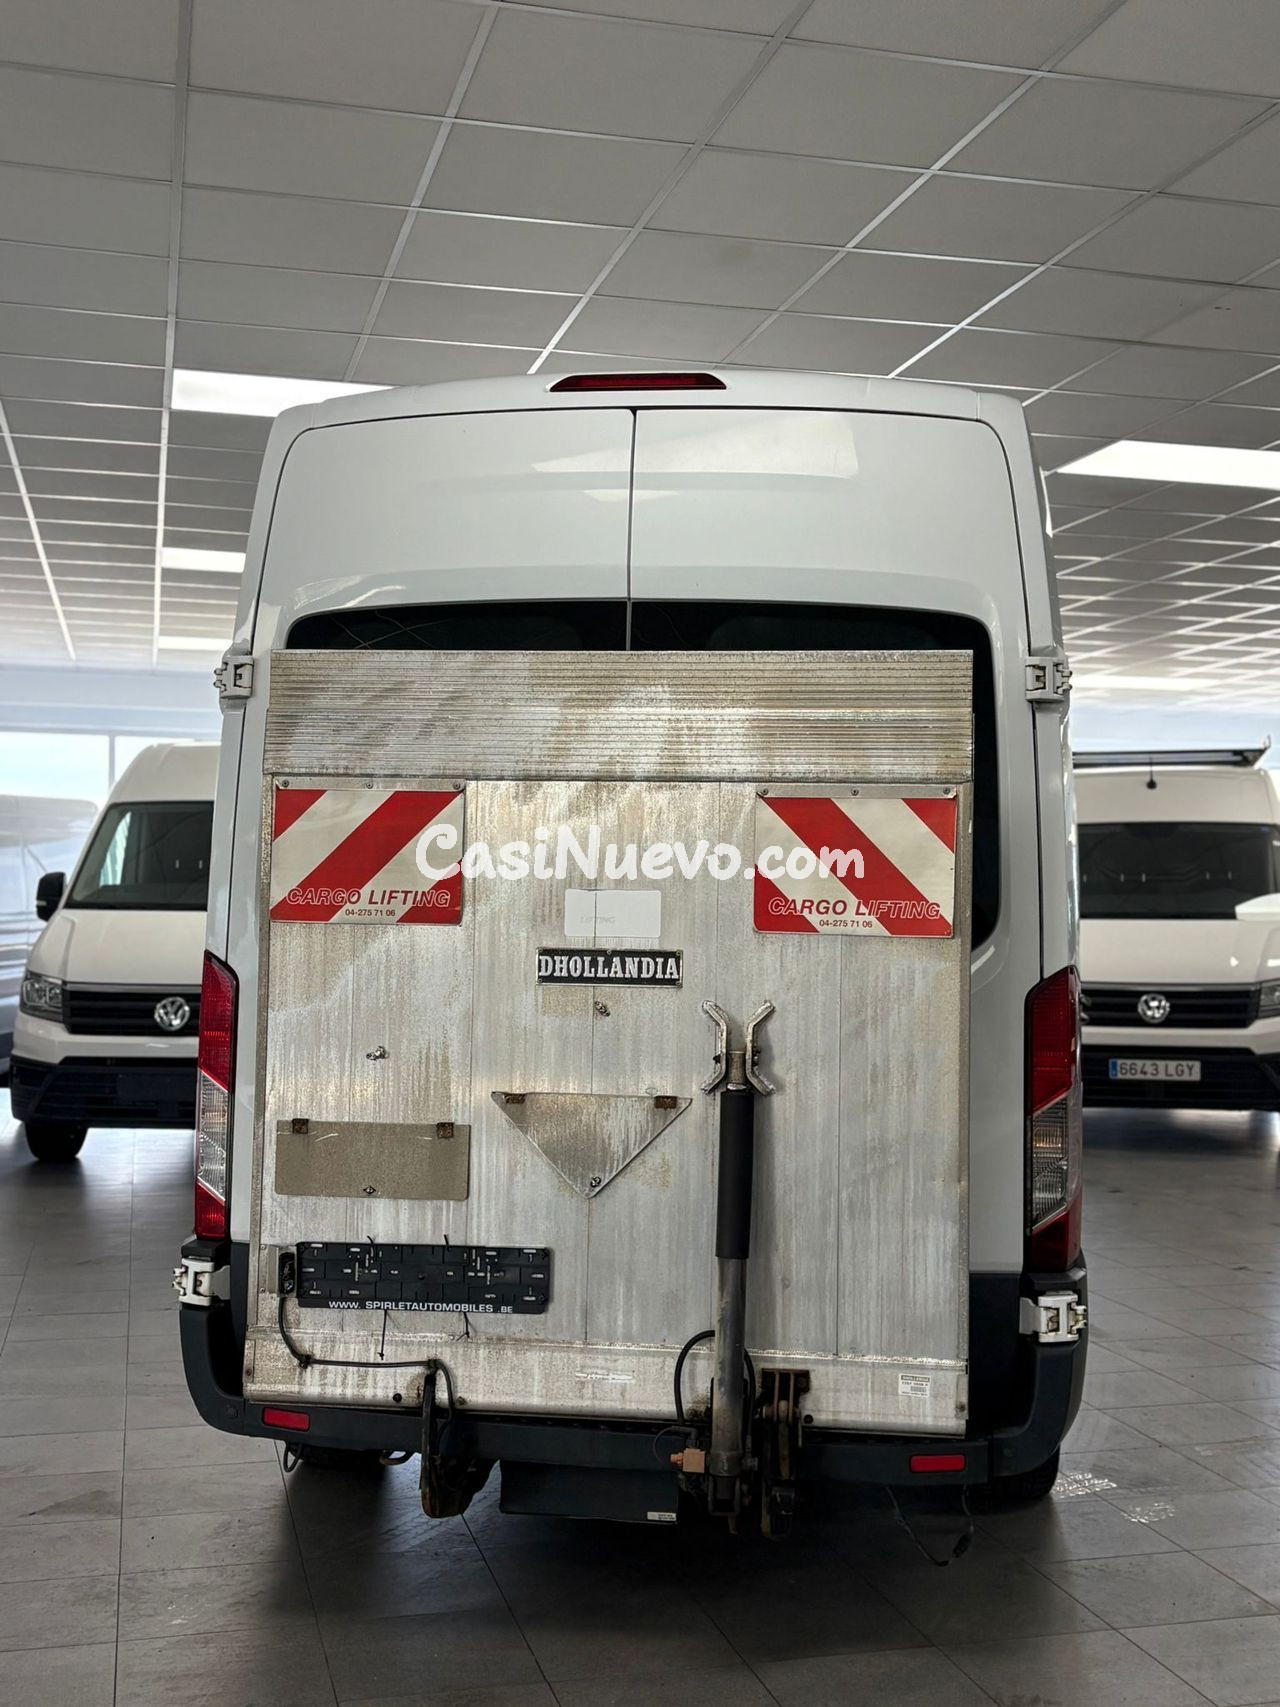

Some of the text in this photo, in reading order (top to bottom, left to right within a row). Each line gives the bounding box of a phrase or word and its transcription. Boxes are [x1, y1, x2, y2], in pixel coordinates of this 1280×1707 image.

[287, 888, 451, 907] CARGO LIFTING
[345, 909, 372, 917] 04-275
[385, 910, 396, 918] 06
[768, 898, 941, 919] CARGO LIFTING
[819, 919, 873, 929] 04-275 71 06
[538, 955, 679, 979] DHOLLANDIA
[1119, 1062, 1194, 1077] 6643 LGY
[365, 1301, 493, 1313] SPIRLETAUTOMOBILES
